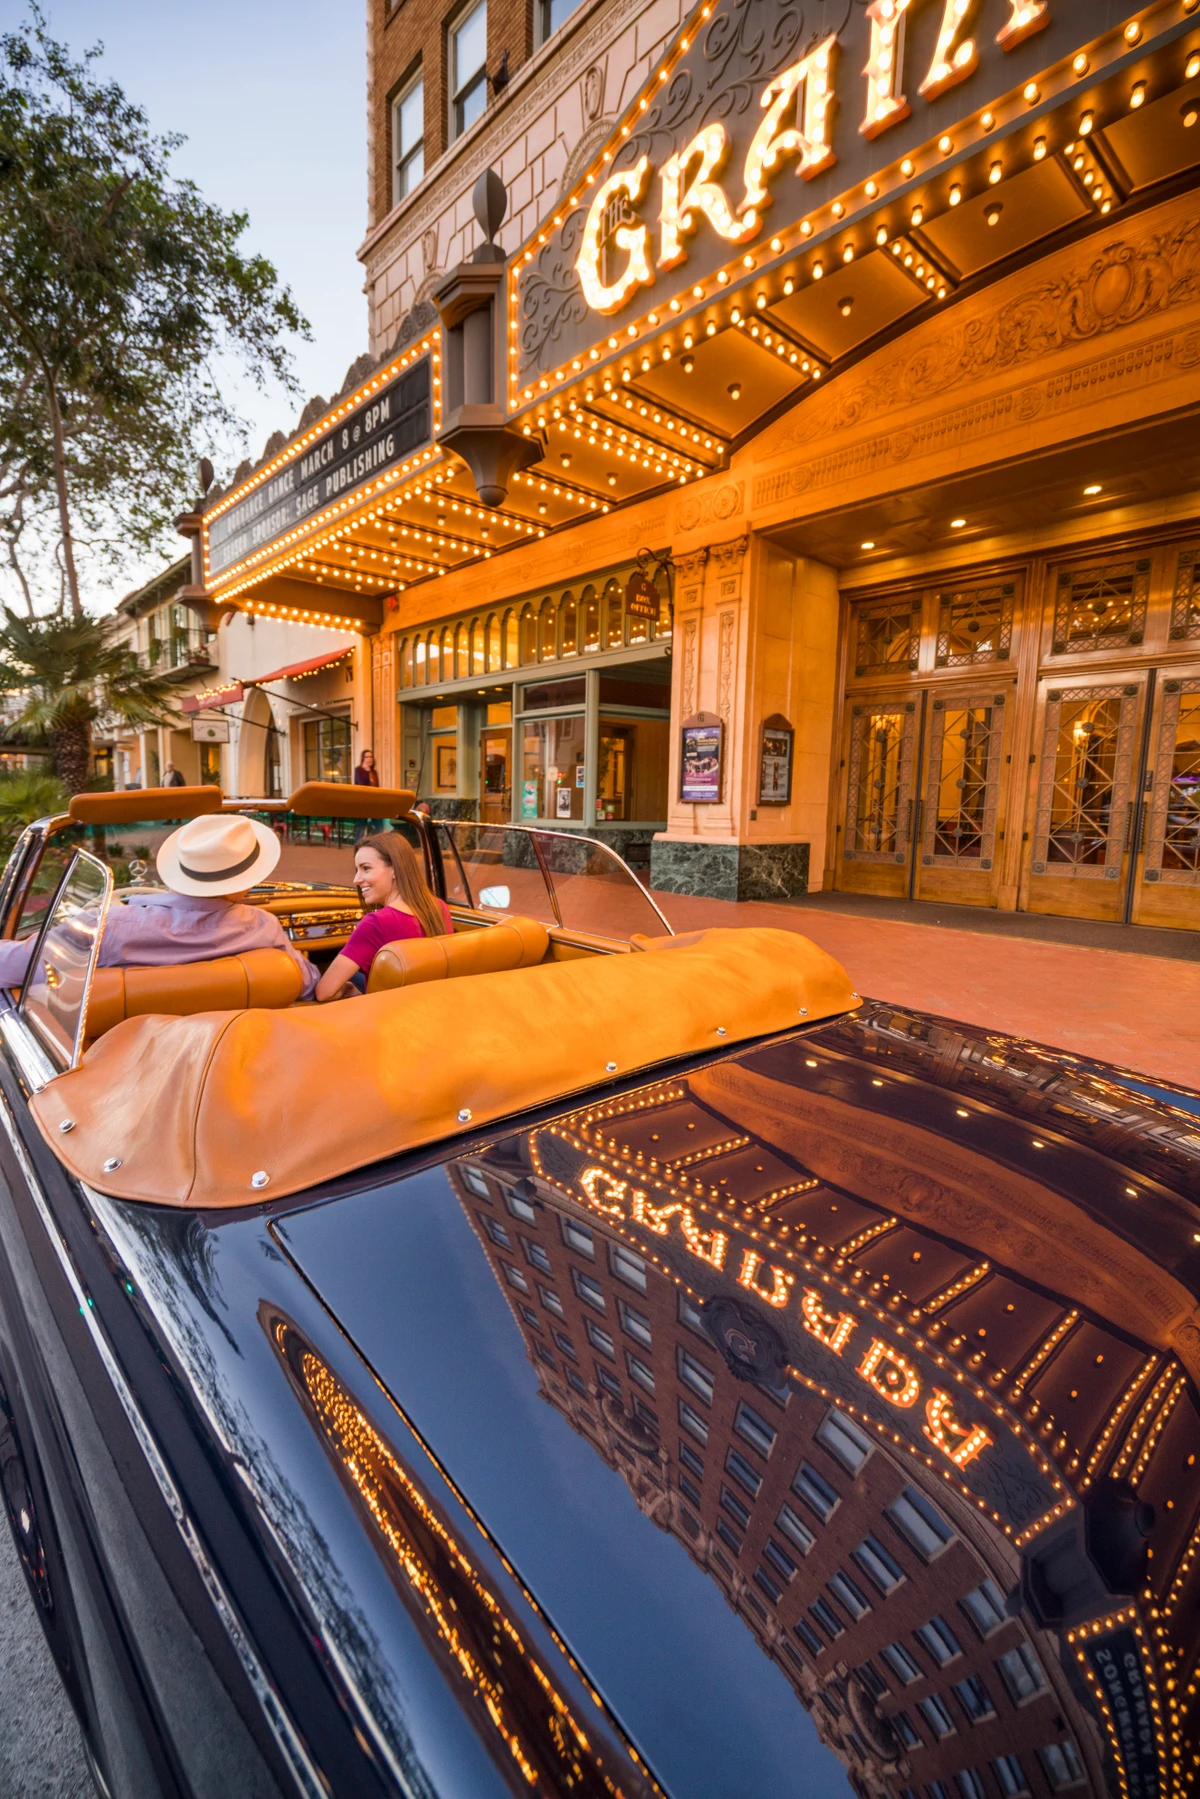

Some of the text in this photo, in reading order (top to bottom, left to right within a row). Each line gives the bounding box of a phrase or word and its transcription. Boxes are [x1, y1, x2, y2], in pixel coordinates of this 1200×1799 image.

[574, 0, 1052, 313] GRAN
[268, 468, 295, 504] DANCE
[301, 439, 334, 481] MARCH
[342, 428, 349, 450] 8
[353, 425, 361, 442] @
[365, 397, 390, 433] 8PM
[296, 485, 319, 516] SAGE
[326, 433, 395, 497] PUBLISHING
[630, 603, 657, 616] OFFICE
[636, 594, 651, 605] BOX
